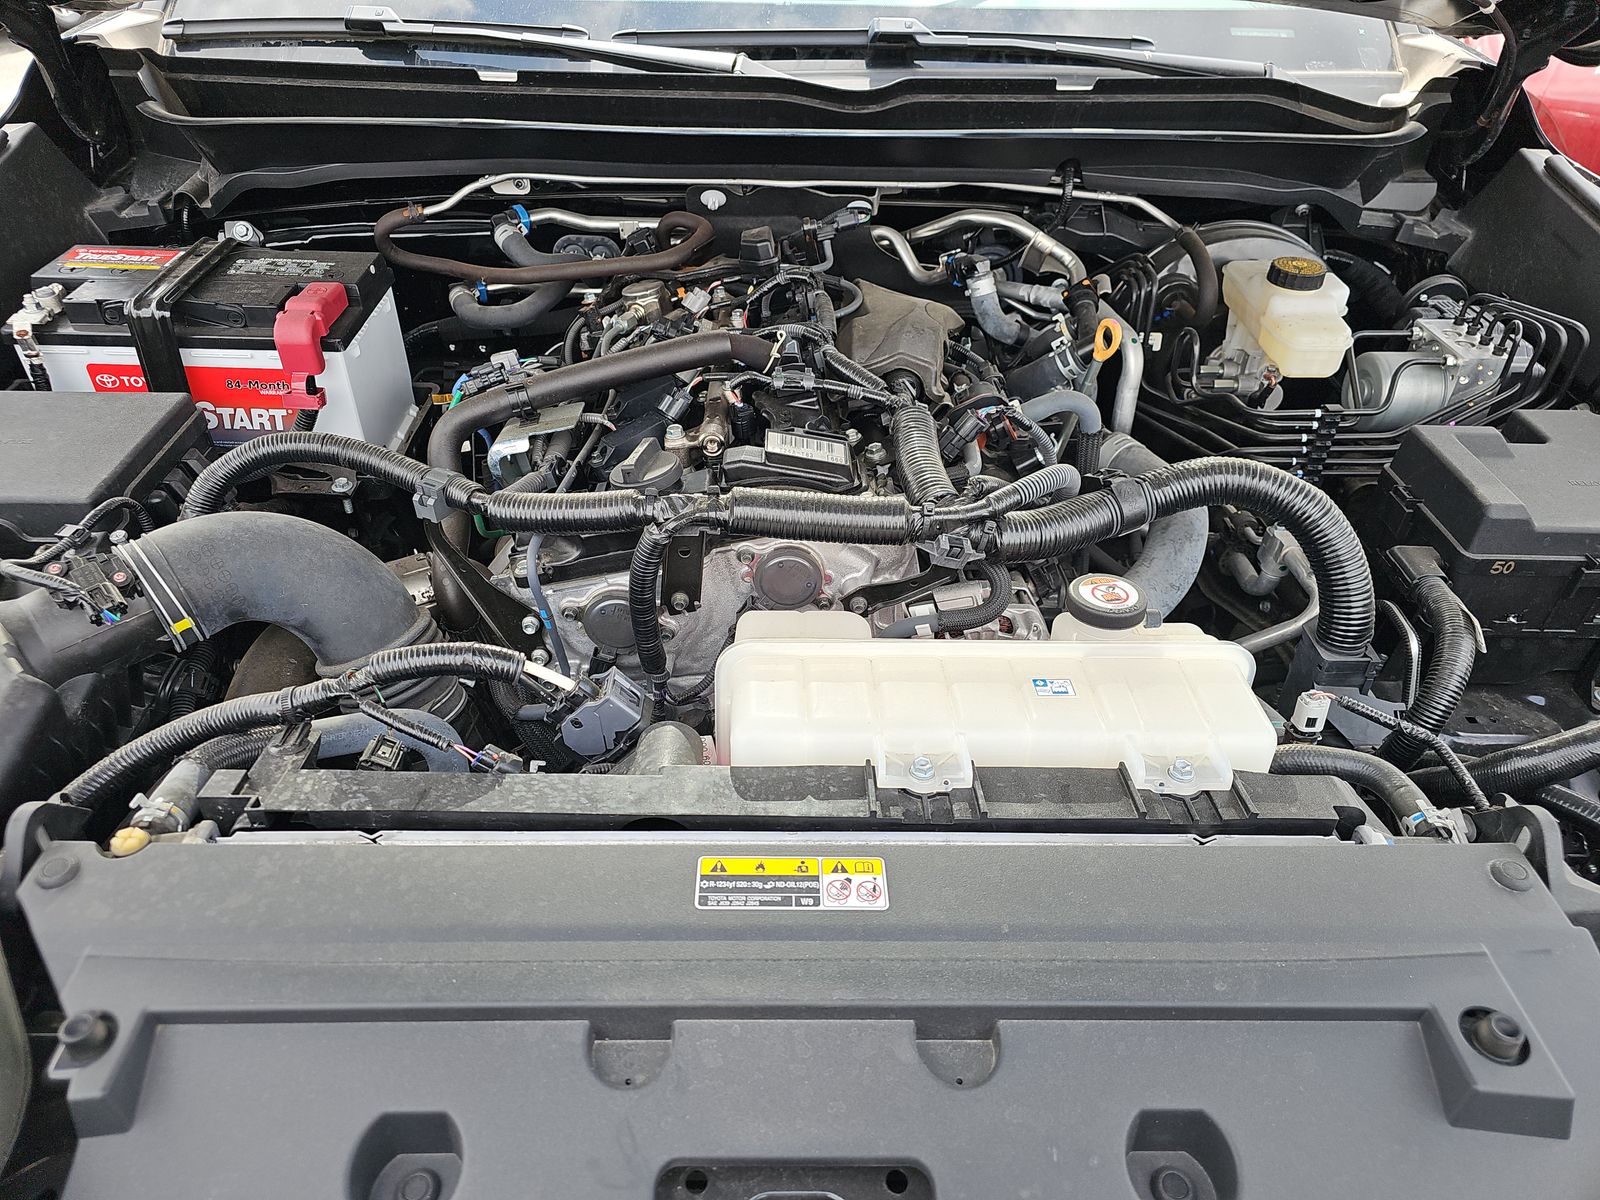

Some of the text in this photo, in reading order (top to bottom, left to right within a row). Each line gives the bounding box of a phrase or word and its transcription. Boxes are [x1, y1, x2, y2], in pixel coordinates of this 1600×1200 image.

[226, 379, 290, 390] 84-Month
[1489, 560, 1516, 575] 50
[800, 897, 814, 906] W9
